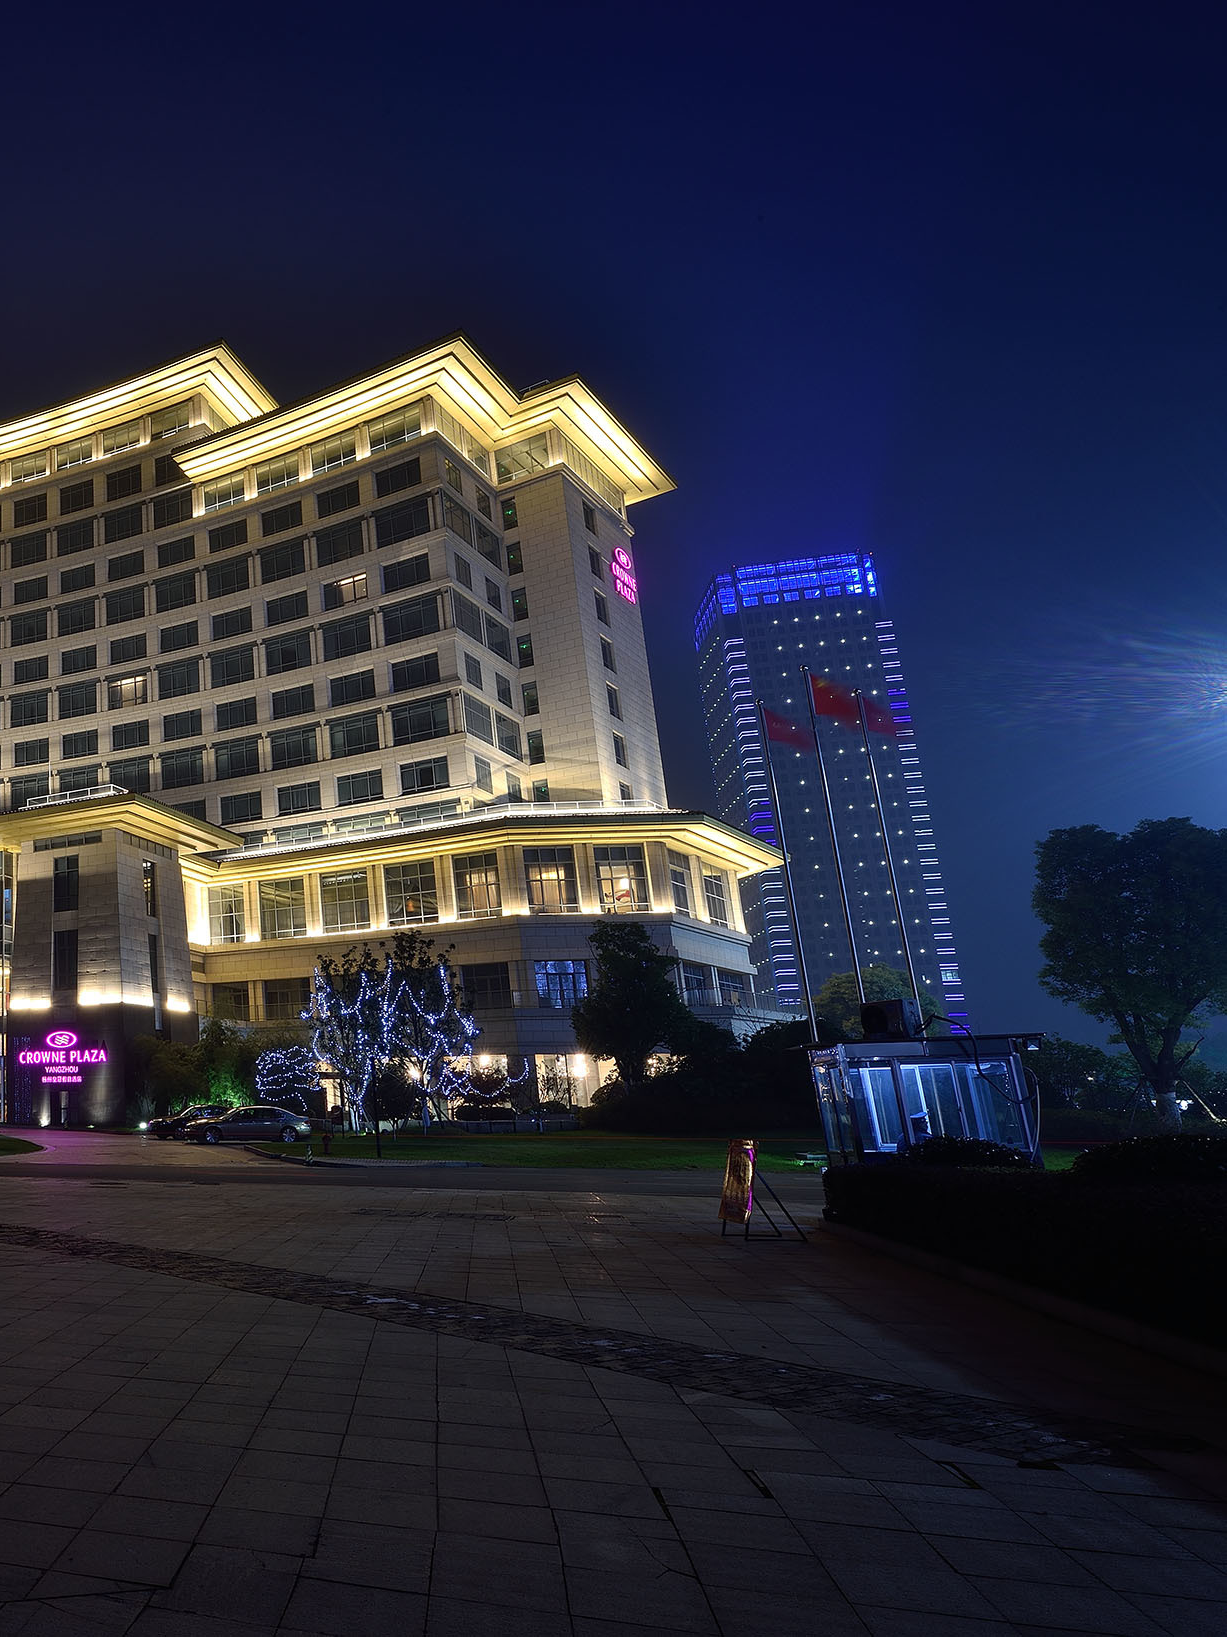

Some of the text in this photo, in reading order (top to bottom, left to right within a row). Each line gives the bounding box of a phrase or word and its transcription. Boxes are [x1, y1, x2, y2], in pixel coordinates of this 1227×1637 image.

[616, 578, 636, 605] PLAZA
[19, 1049, 107, 1064] CROWNE PLAZA
[44, 1065, 79, 1074] YANGZHOU
